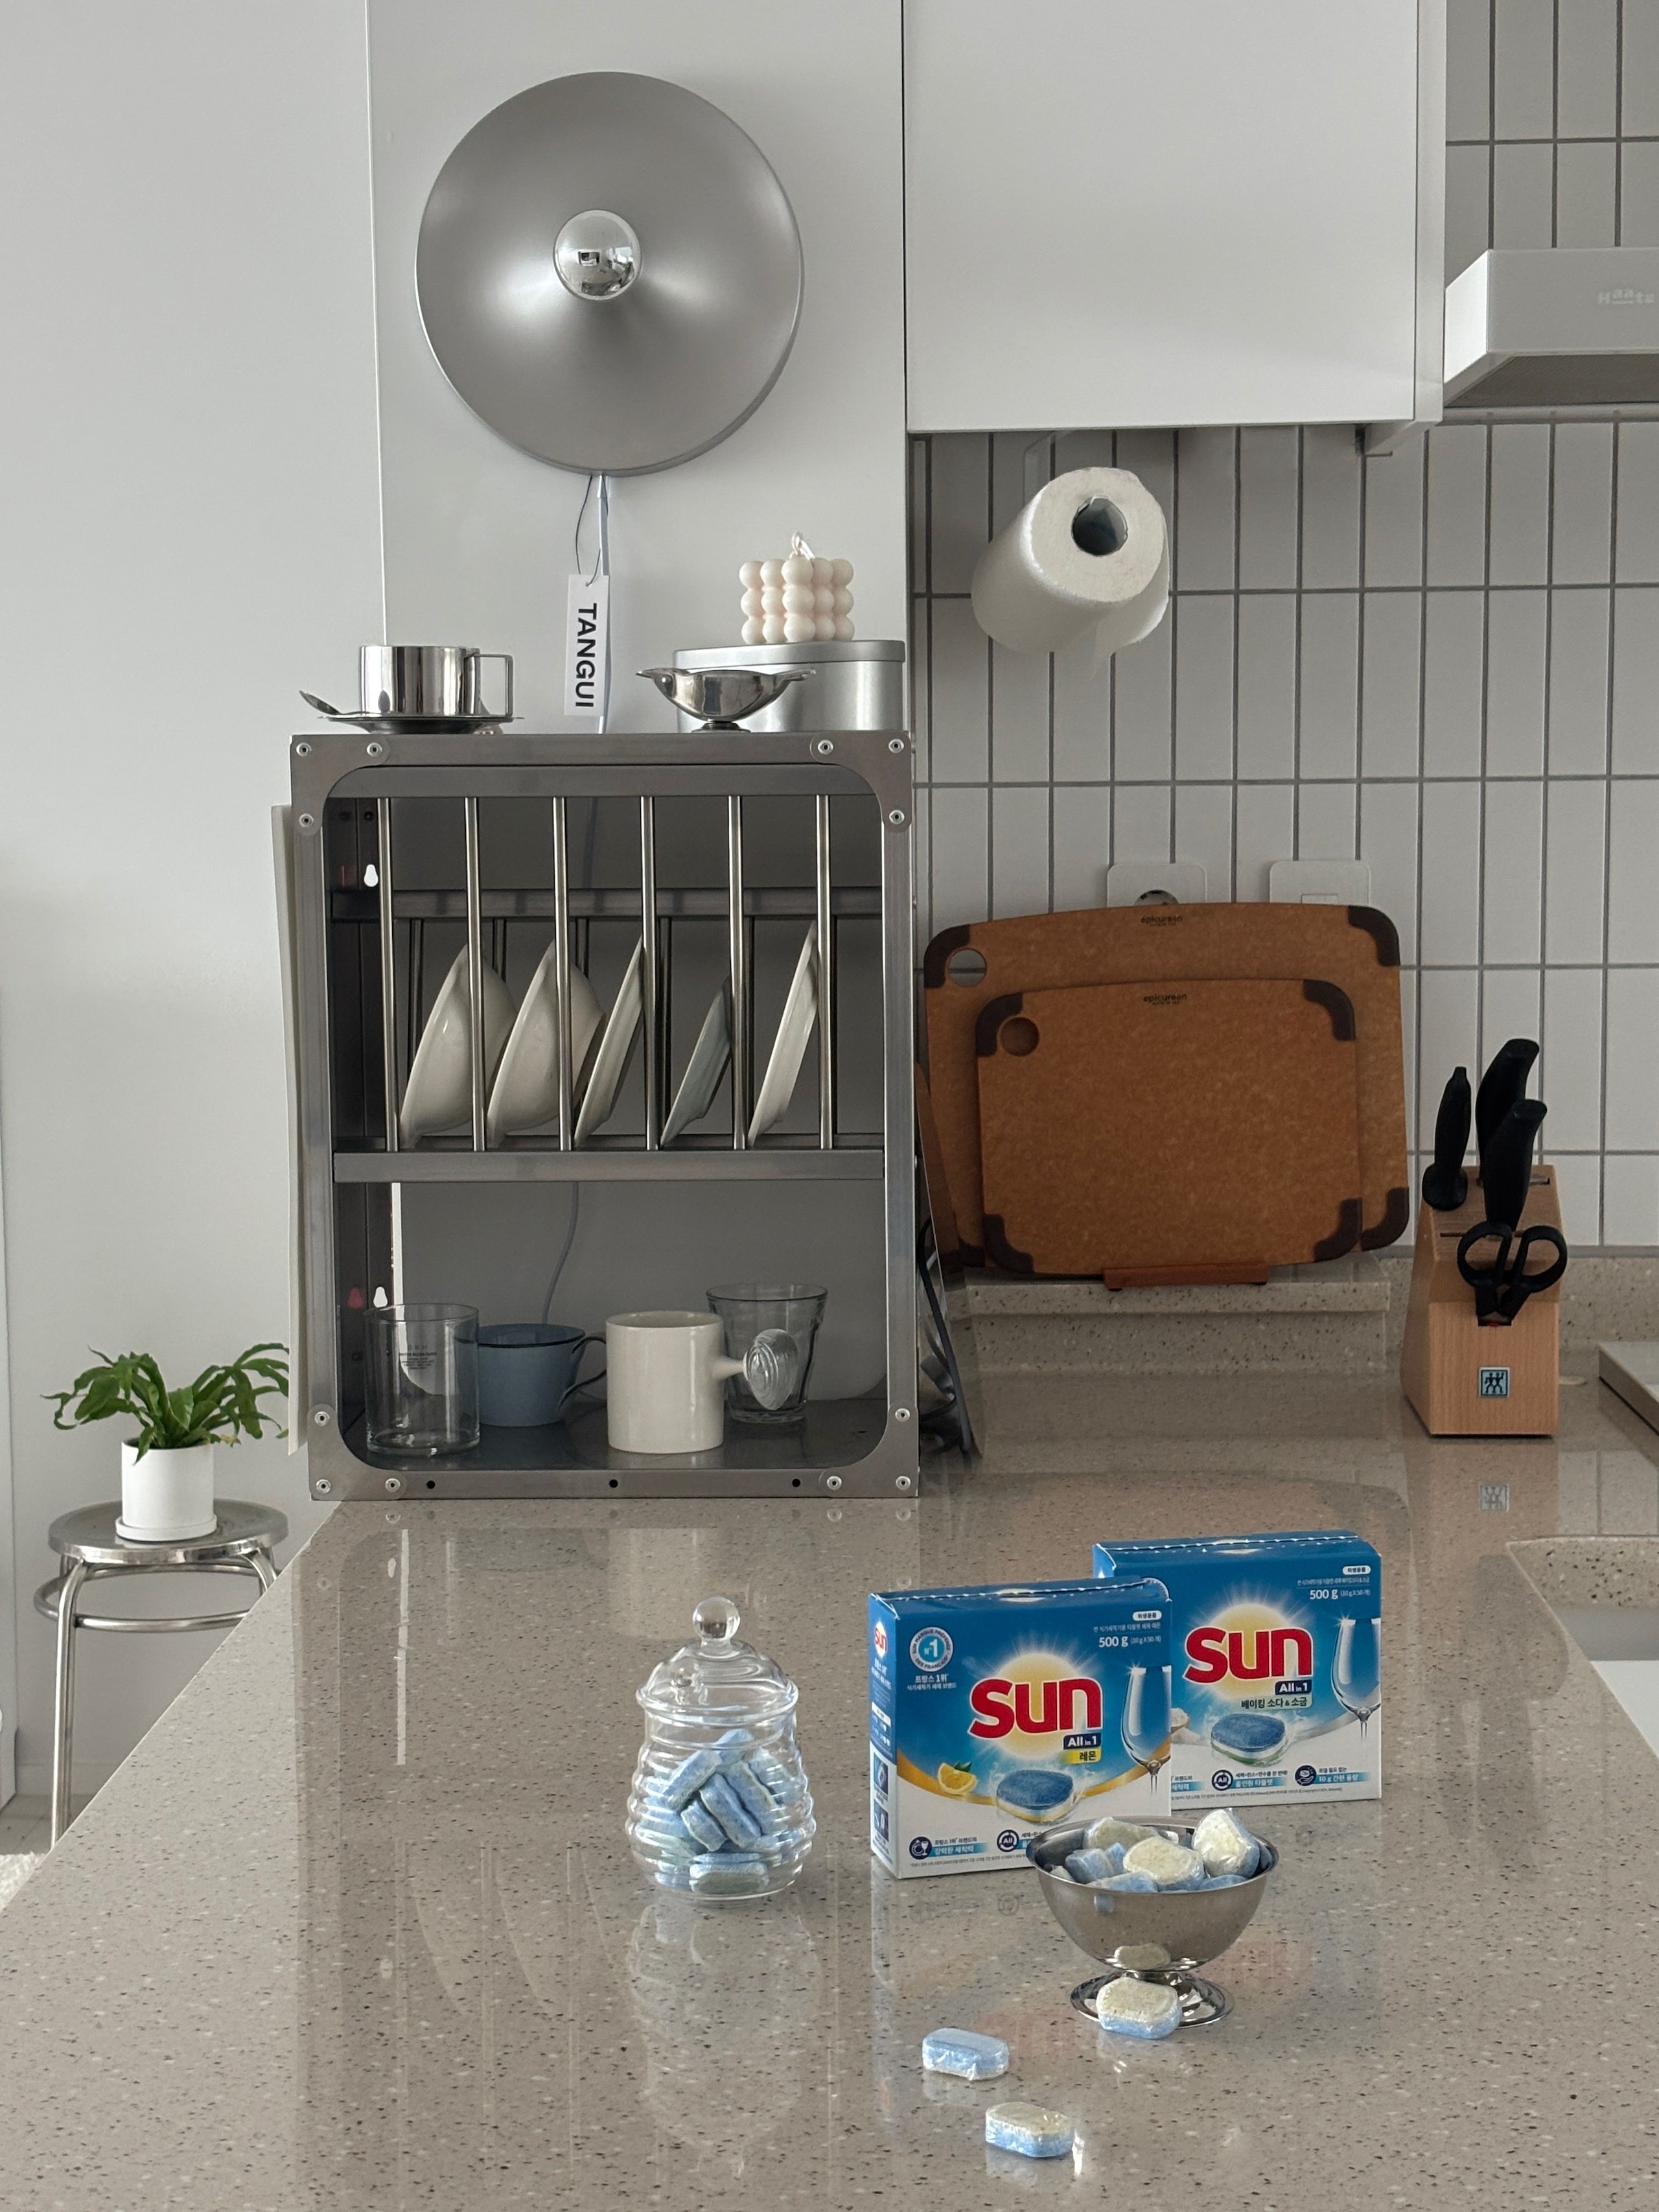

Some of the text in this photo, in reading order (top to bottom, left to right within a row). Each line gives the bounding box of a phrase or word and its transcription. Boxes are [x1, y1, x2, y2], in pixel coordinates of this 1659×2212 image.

[575, 603, 597, 708] TANGUI
[1143, 994, 1187, 1002] epicurean
[1310, 1589, 1329, 1600] 500
[1331, 1589, 1338, 1600] g
[1098, 1636, 1119, 1647] 500
[1121, 1636, 1128, 1647] g
[915, 1675, 934, 1683] 프랑스
[1279, 1682, 1294, 1693] All
[1303, 1682, 1308, 1691] 1
[1241, 1699, 1265, 1709] 베이킹
[1267, 1697, 1284, 1707] 소다
[1291, 1697, 1307, 1706] 소금
[1067, 1736, 1084, 1747] All
[1092, 1736, 1096, 1745] 1
[1079, 1751, 1097, 1762] 레몬
[934, 1845, 974, 1856] 강력한 세척력
